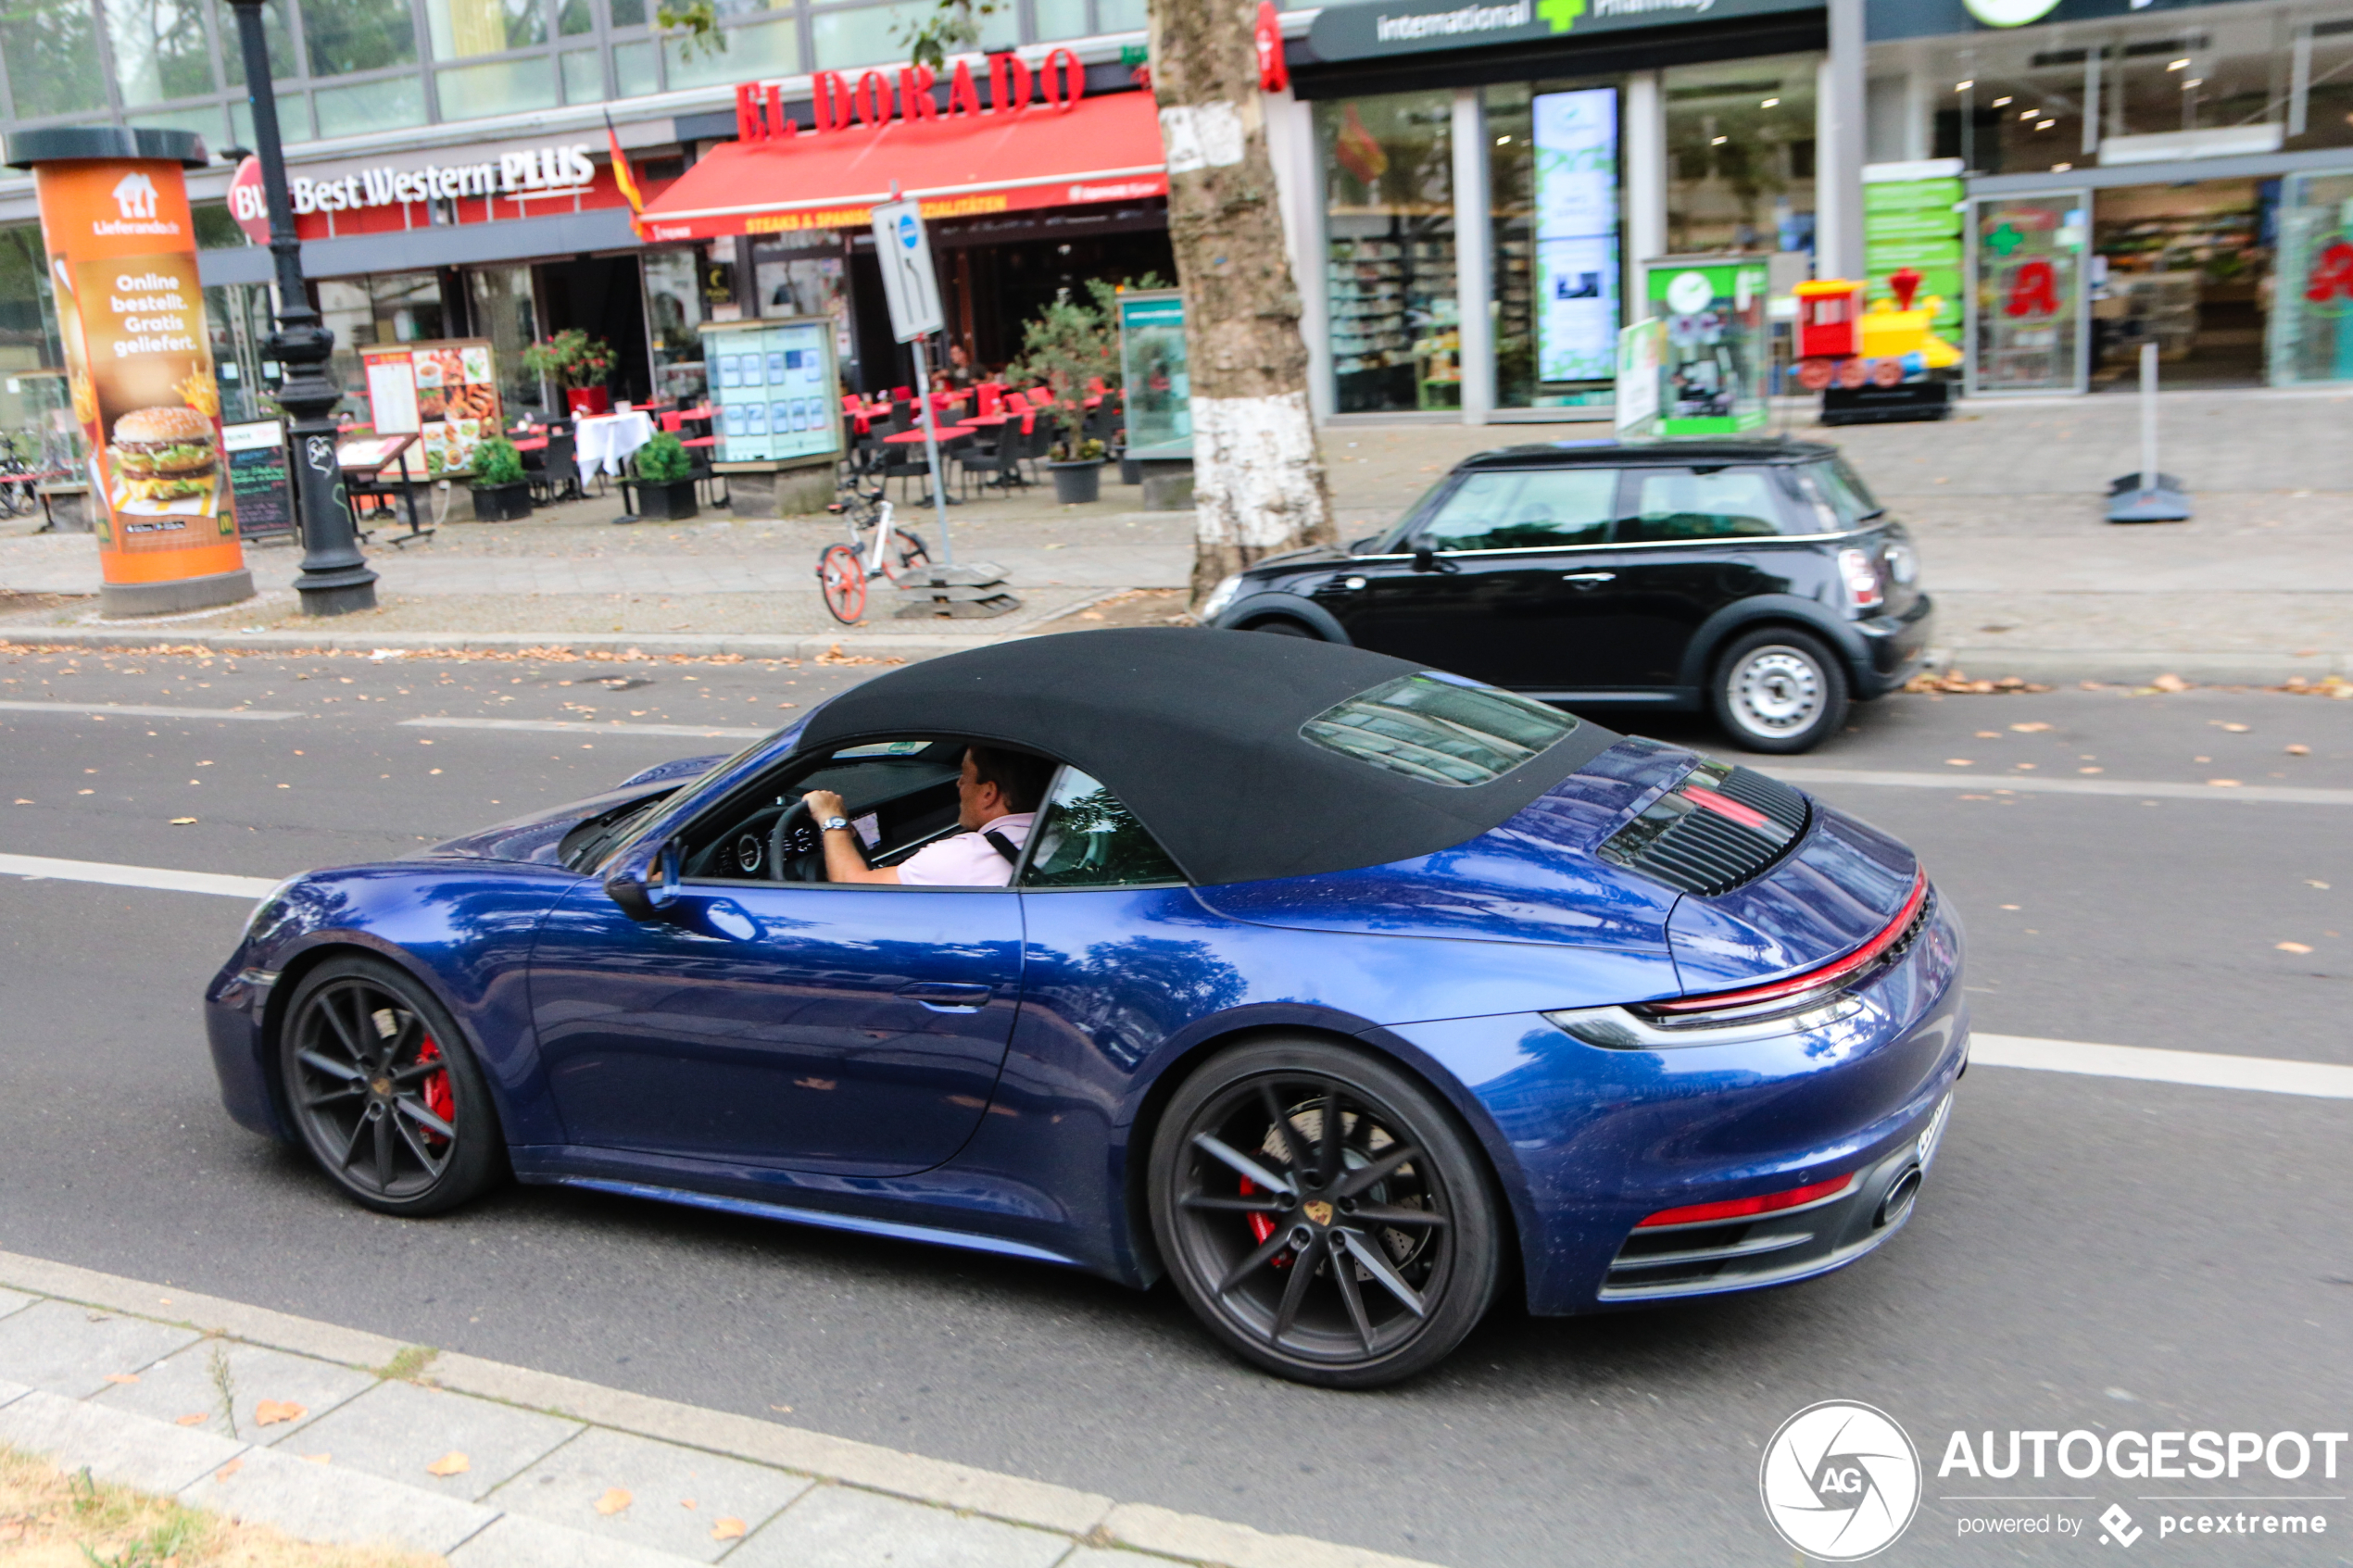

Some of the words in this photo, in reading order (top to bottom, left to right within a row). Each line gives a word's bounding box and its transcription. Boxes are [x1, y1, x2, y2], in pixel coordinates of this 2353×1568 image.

[735, 81, 799, 143] EL
[810, 46, 1087, 133] DORADO
[293, 173, 363, 215] Best
[362, 159, 496, 207] Western
[499, 143, 597, 191] PLUS
[117, 272, 180, 293] Online
[110, 292, 188, 314] bestellt.
[125, 313, 185, 333] Gratis
[113, 333, 197, 358] geliefert.
